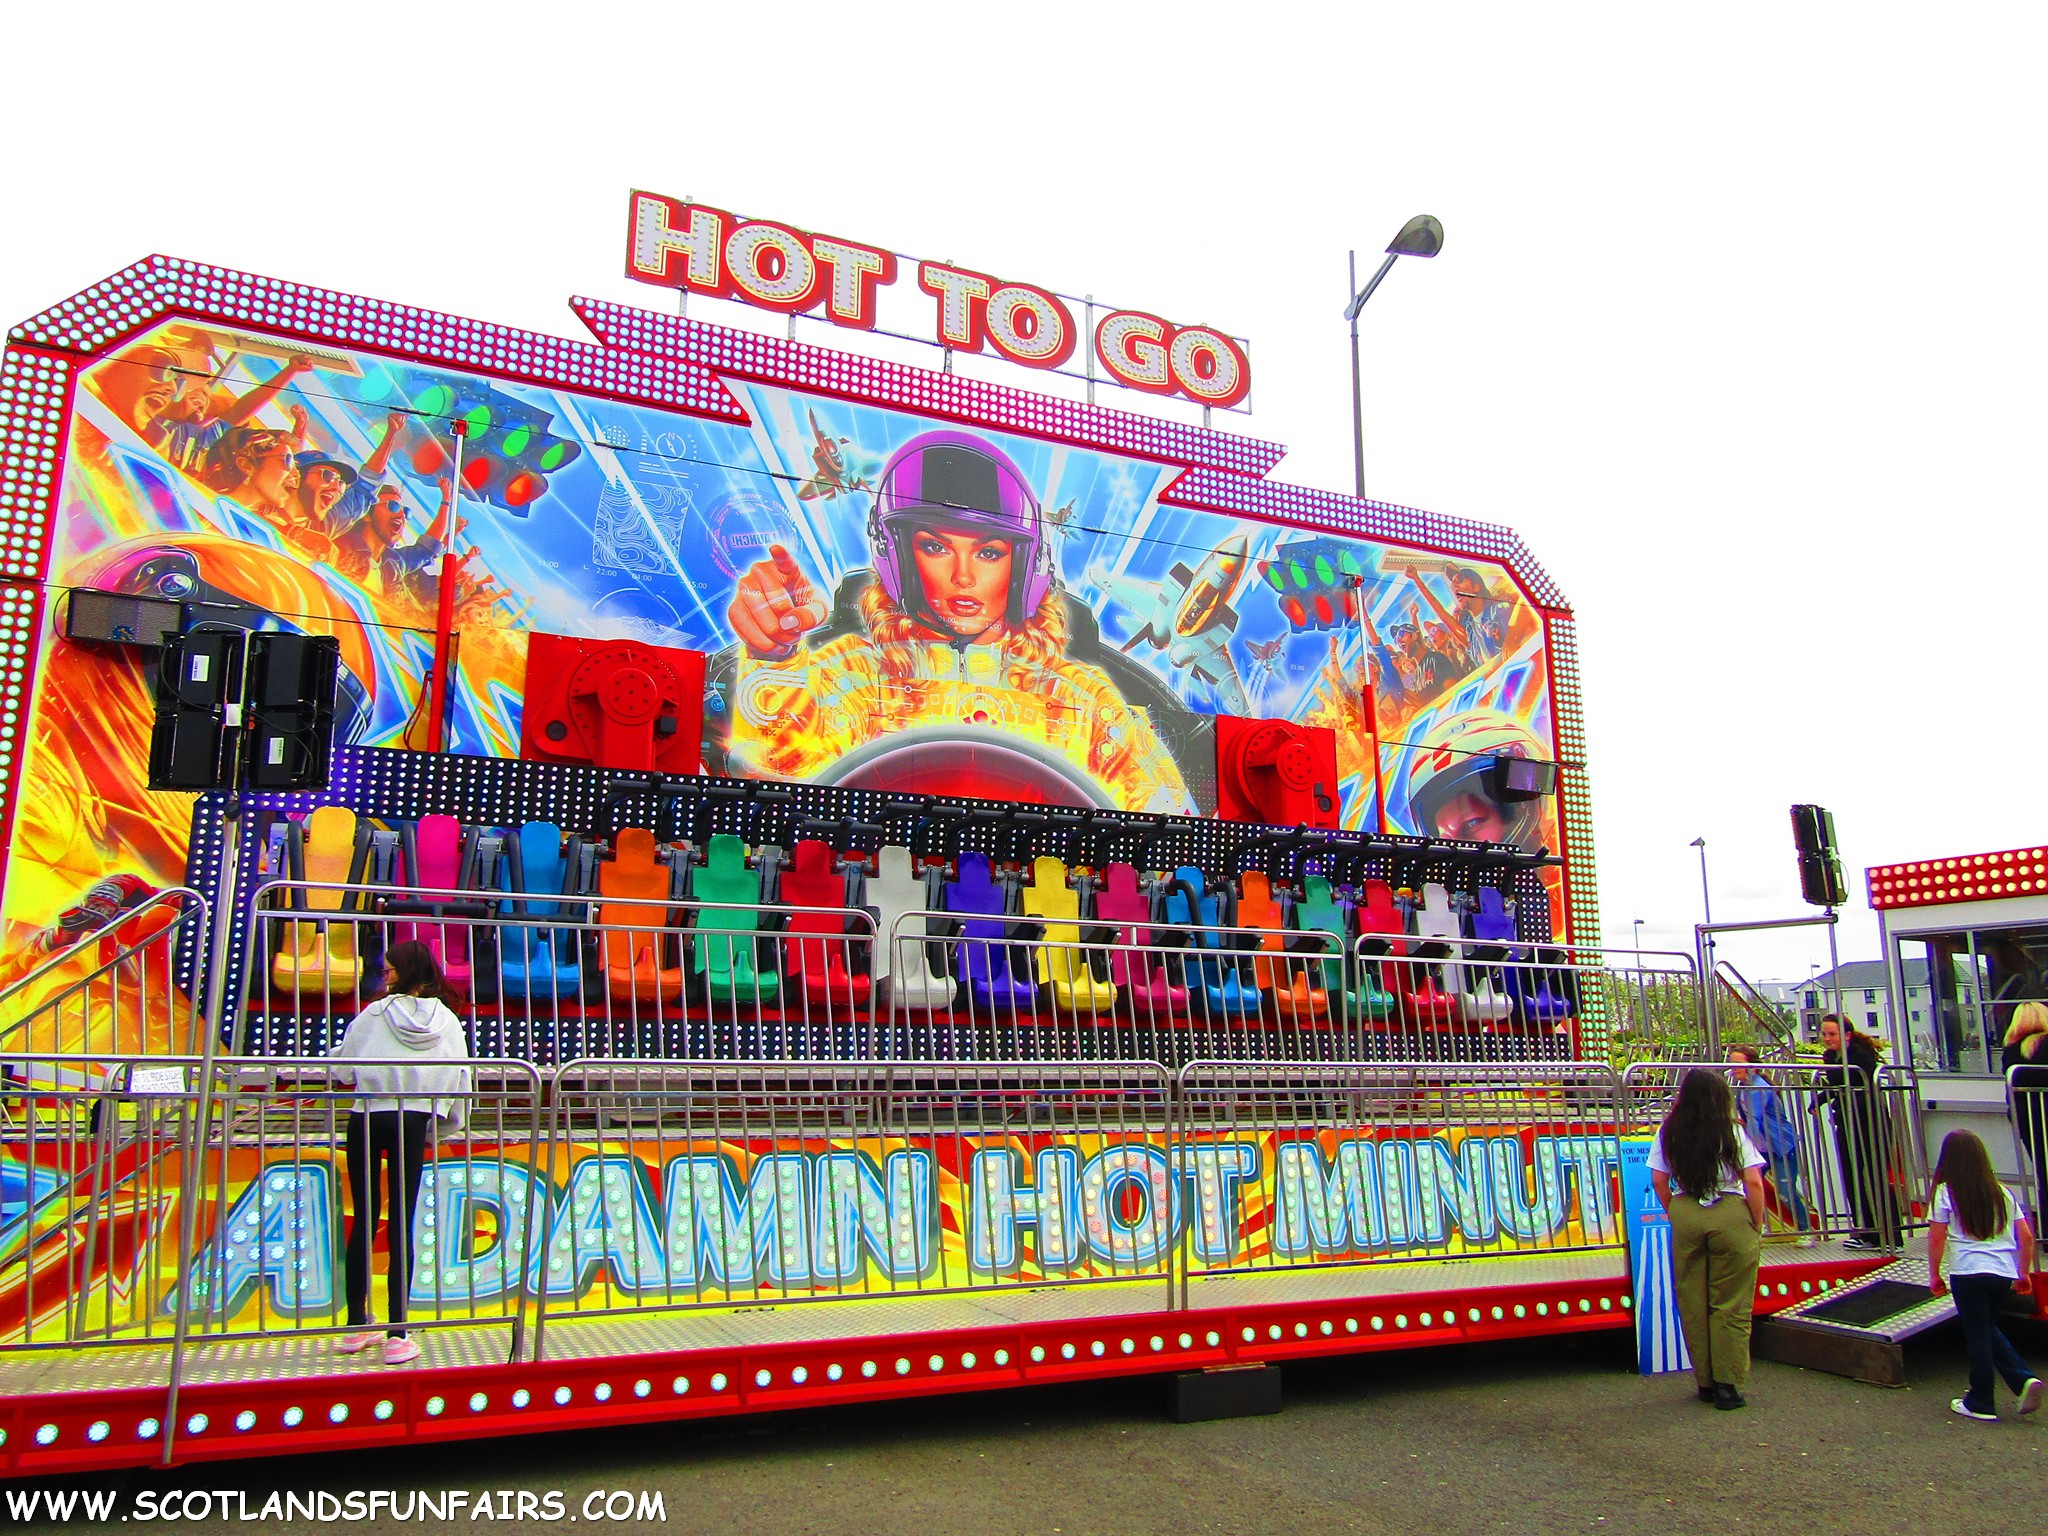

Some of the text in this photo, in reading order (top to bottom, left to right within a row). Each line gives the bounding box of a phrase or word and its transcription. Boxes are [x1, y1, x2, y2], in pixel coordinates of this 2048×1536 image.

[633, 194, 1240, 398] HOT TO GO
[166, 1136, 1621, 1311] A DAMN HOT MINUT
[1637, 1147, 1650, 1155] MUS
